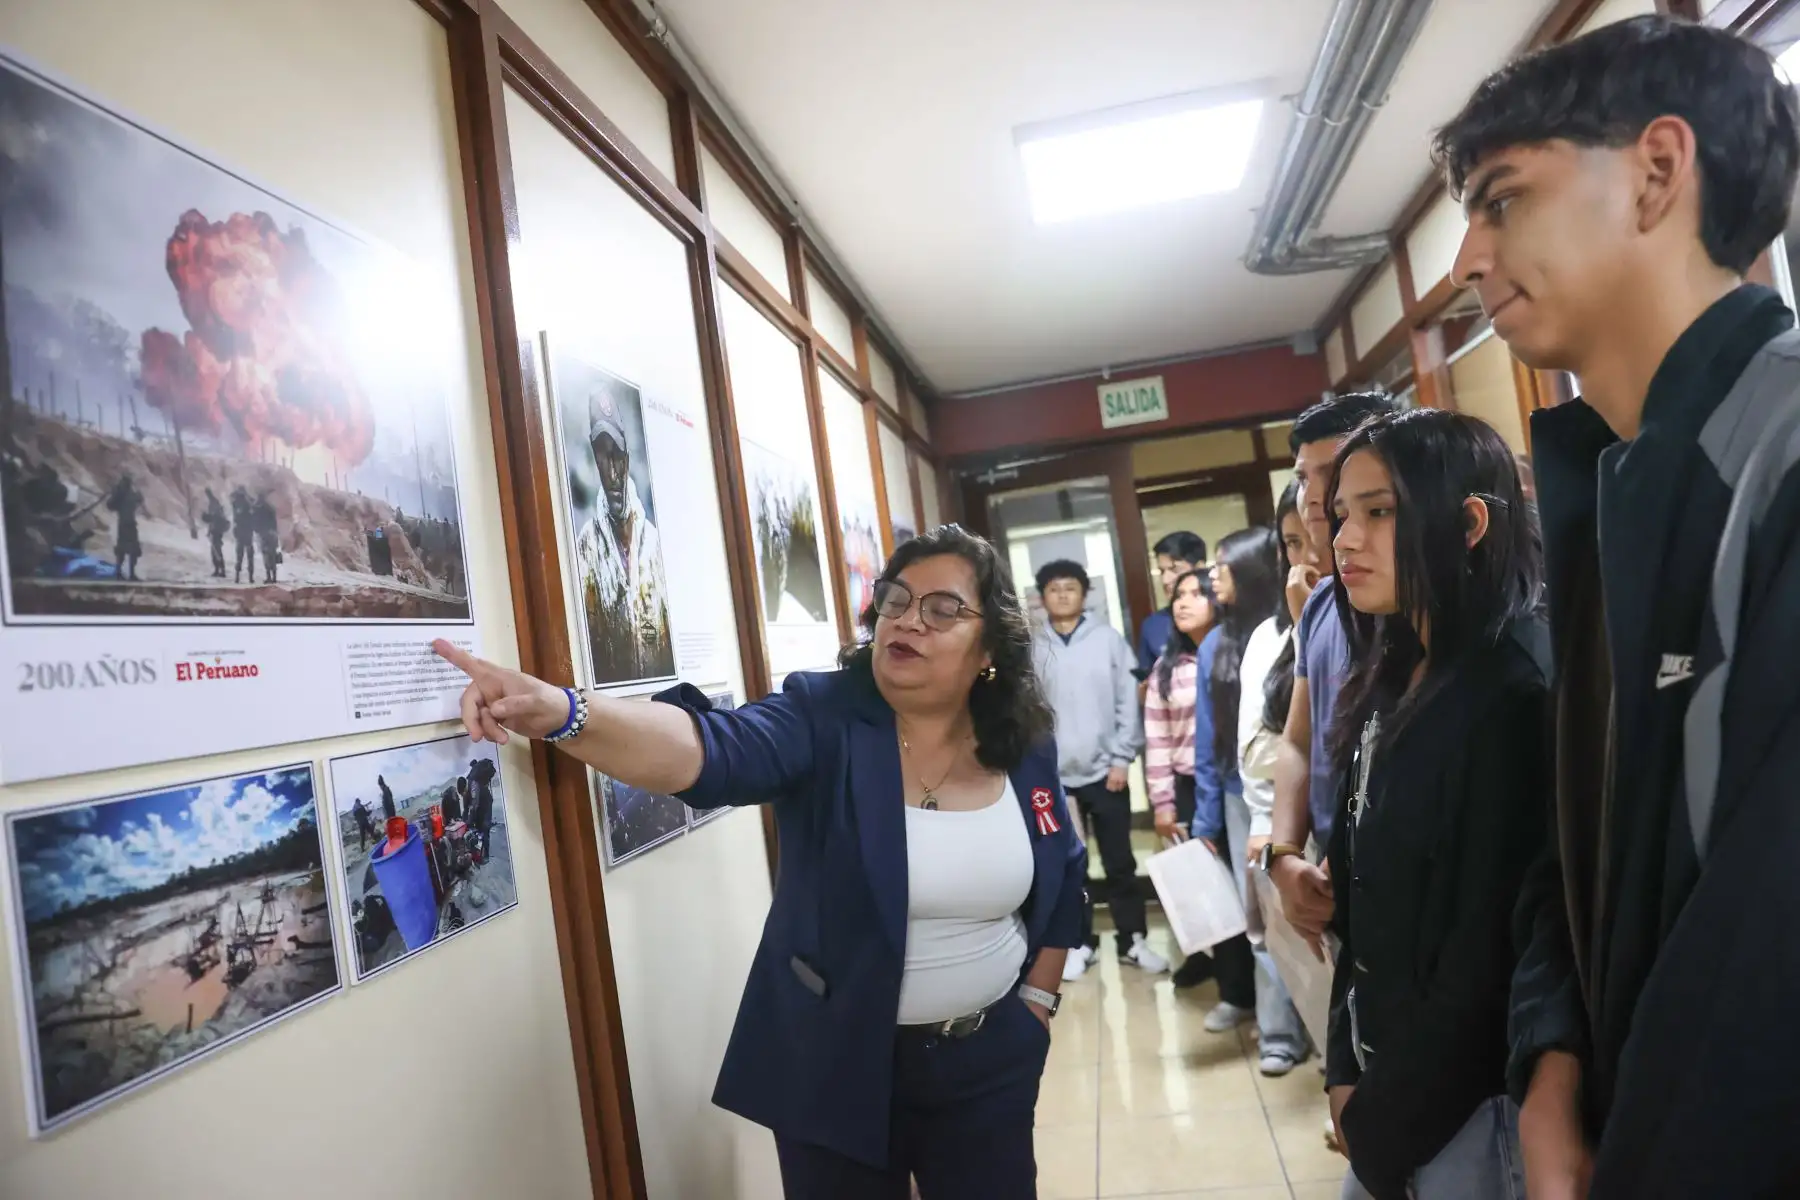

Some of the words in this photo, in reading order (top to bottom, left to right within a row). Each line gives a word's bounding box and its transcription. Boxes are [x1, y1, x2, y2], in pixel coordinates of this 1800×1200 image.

[1105, 386, 1161, 418] SALIDA
[17, 661, 75, 692] 200
[79, 654, 157, 689] AÑOS
[176, 662, 192, 681] El
[196, 661, 259, 680] Peruano
[1661, 653, 1694, 674] NIKE
